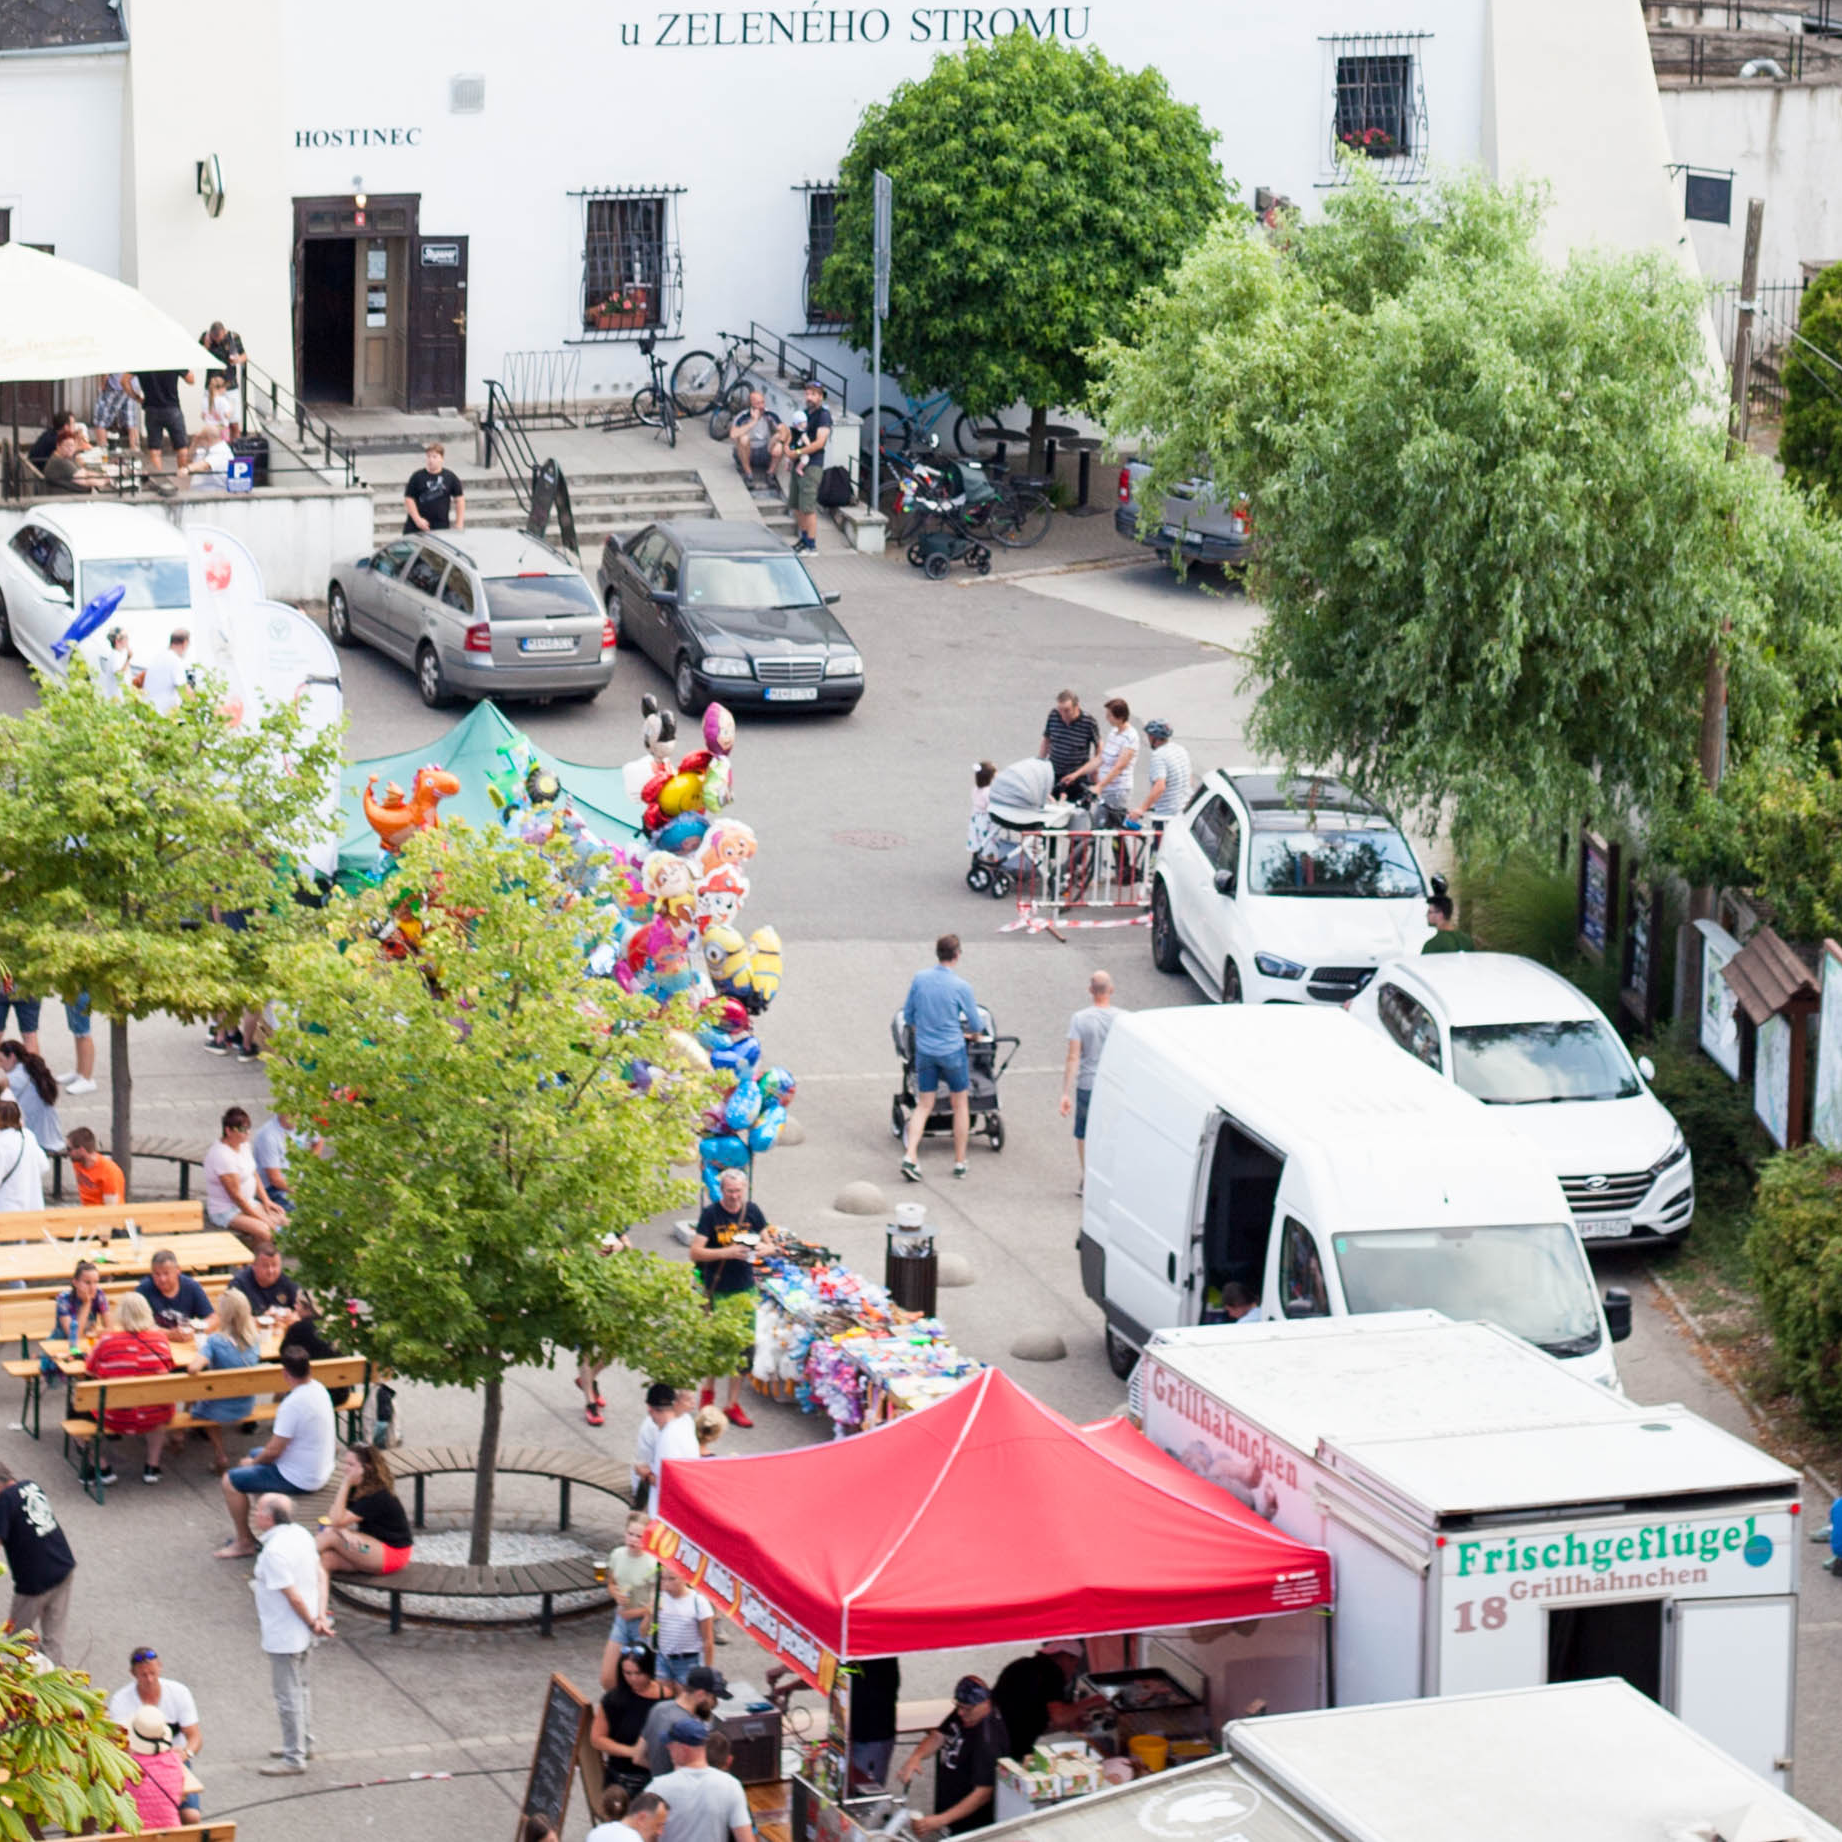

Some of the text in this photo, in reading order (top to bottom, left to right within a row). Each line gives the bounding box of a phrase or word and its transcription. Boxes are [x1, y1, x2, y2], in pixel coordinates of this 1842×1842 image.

[655, 0, 891, 46] ZELENÉHO
[910, 6, 1091, 42] STROMU
[295, 127, 422, 148] HOSTINEC
[234, 462, 248, 478] P
[1457, 1516, 1756, 1577] Frischgeflügel
[1454, 1597, 1508, 1633] 18
